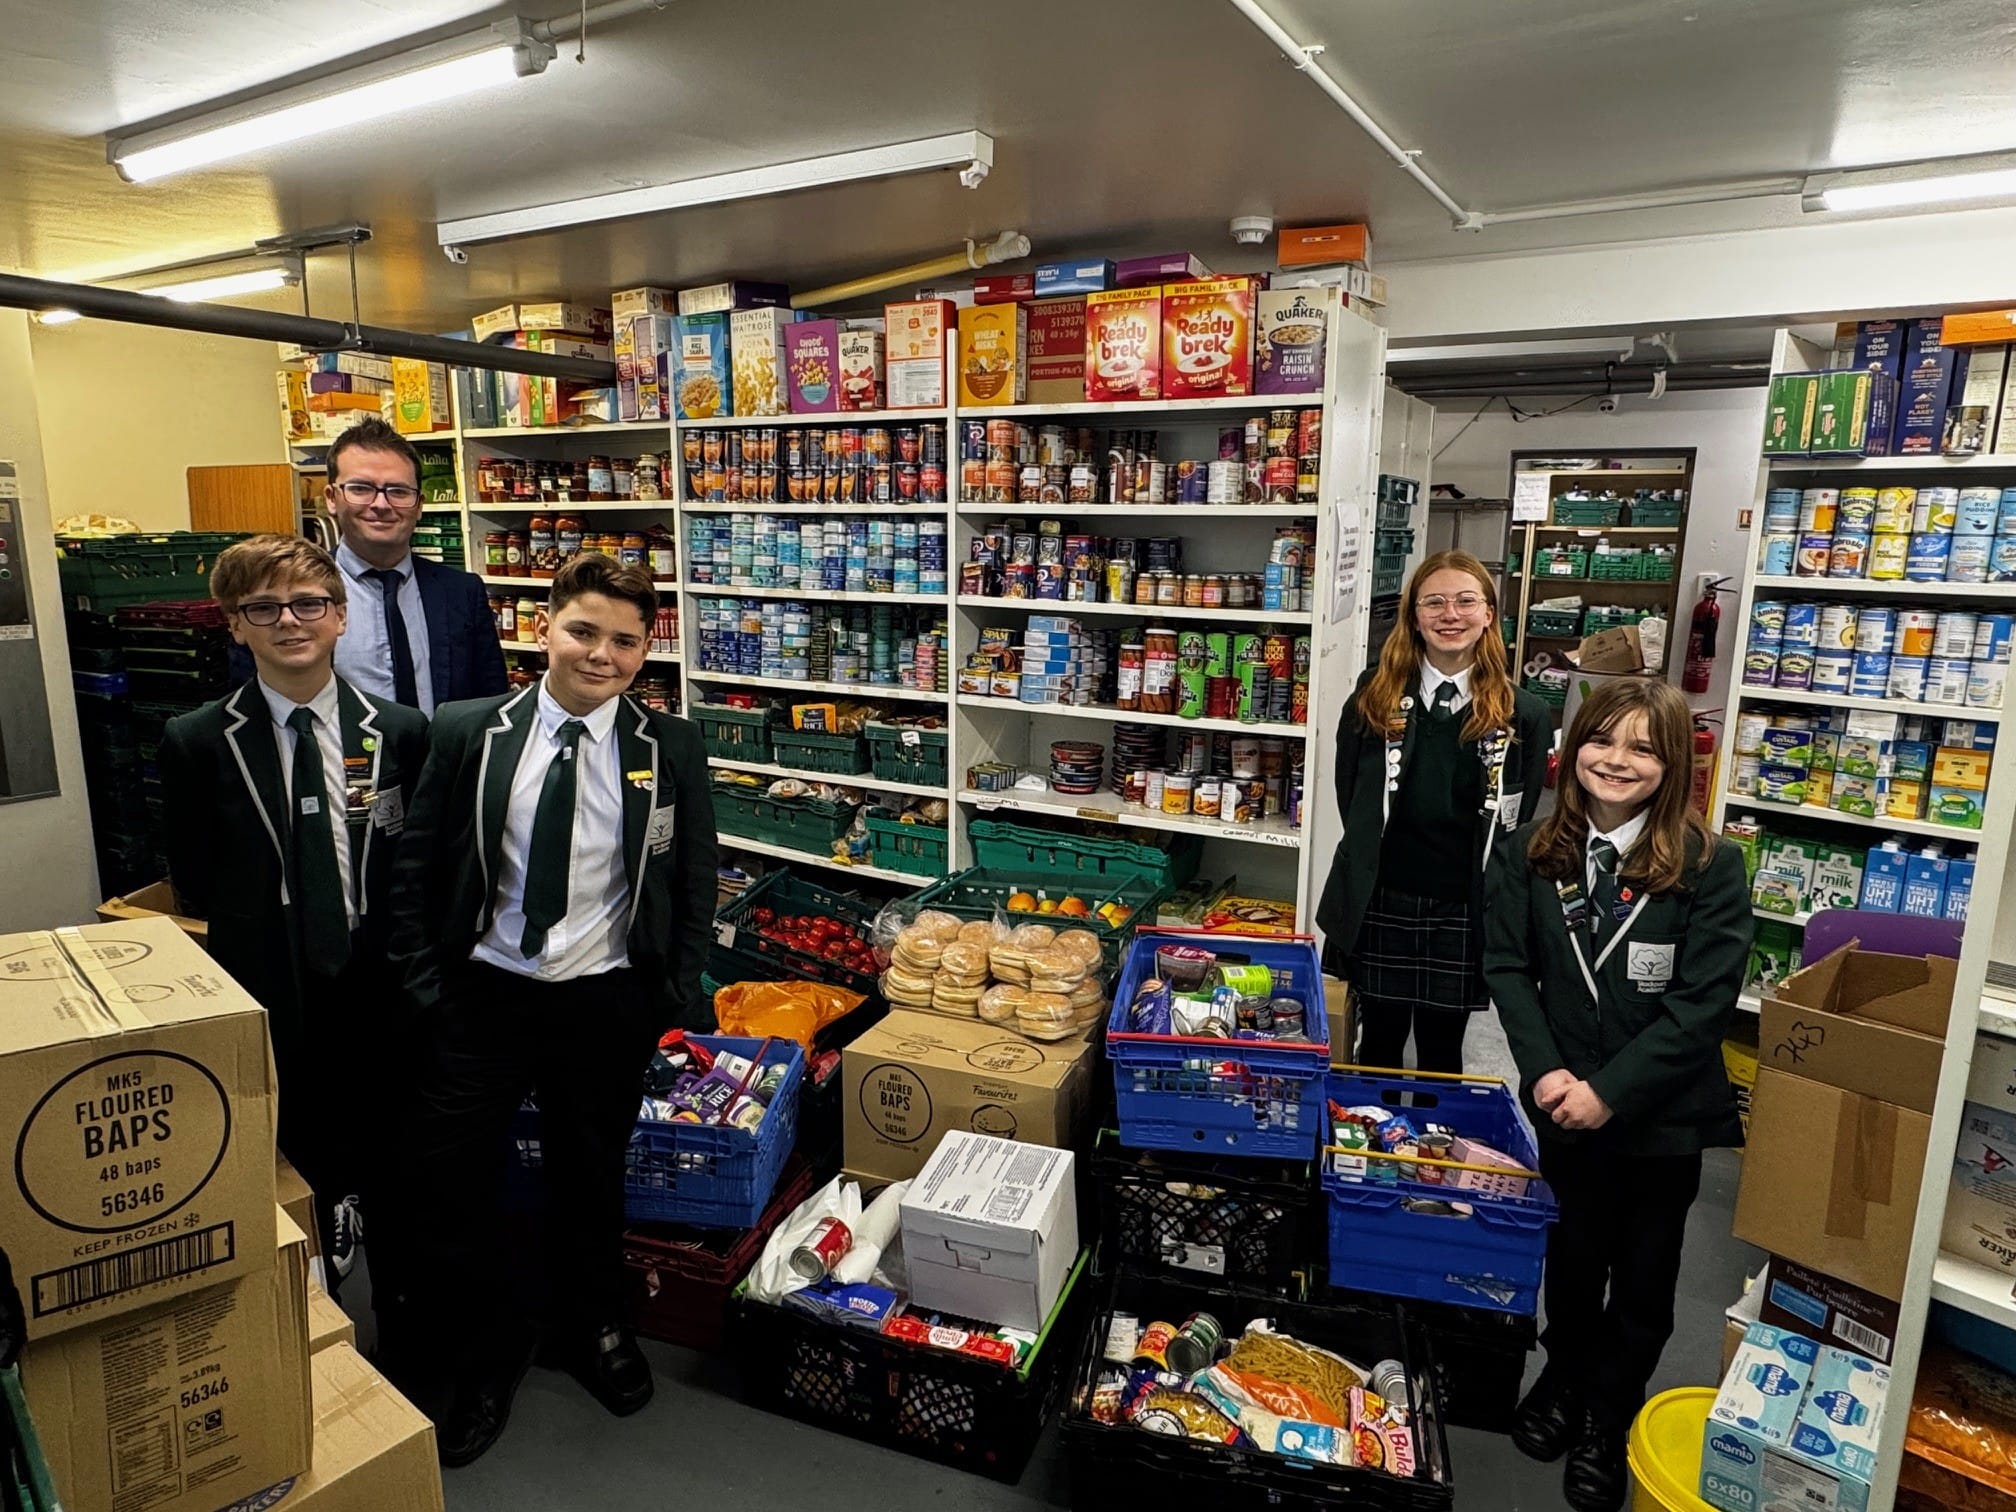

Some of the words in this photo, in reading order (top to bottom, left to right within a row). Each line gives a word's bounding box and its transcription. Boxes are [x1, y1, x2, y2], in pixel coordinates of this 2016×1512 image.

[1108, 291, 1132, 301] FAMILY
[1133, 289, 1152, 298] PACK
[1174, 285, 1188, 294] BIG
[1189, 283, 1217, 293] FAMILY
[1218, 281, 1239, 291] PACK
[732, 311, 772, 323] ESSENTIAL
[1051, 316, 1086, 328] 5139370
[1275, 307, 1325, 322] QUAKER
[974, 329, 1000, 341] WHEAT
[1098, 321, 1148, 344] Ready
[1176, 317, 1235, 338] Ready
[1871, 336, 1886, 345] ON
[1925, 332, 1940, 340] ON
[793, 347, 830, 358] SQUARES
[841, 345, 870, 357] QUAKER
[1101, 341, 1142, 361] brek
[1181, 334, 1227, 356] brek
[1866, 342, 1890, 352] YOUR
[1919, 346, 1943, 354] SIDE!
[1282, 355, 1313, 365] RAISIN
[1865, 350, 1889, 358] SIDE!
[1187, 369, 1223, 384] original
[1279, 363, 1316, 375] CRUNCH
[1106, 375, 1138, 388] original
[982, 630, 1009, 641] SPAM
[1268, 645, 1286, 653] HOT
[972, 656, 994, 666] SPAM
[1774, 864, 1805, 877] milk
[1819, 873, 1854, 889] milk
[1865, 886, 1895, 901] UHT
[1863, 896, 1894, 909] MILK
[1906, 894, 1937, 909] UHT
[1948, 900, 1969, 913] UH
[1904, 904, 1936, 917] MILK
[1946, 910, 1968, 921] MIL
[106, 1070, 142, 1092] MK5
[878, 1080, 912, 1096] FLOURED
[708, 1085, 736, 1112] RICE
[972, 1084, 1018, 1101] Favourites
[75, 1083, 174, 1125] FLOURED
[880, 1093, 911, 1111] BAPS
[84, 1109, 172, 1160] BAPS
[884, 1123, 907, 1137] 56346
[100, 1165, 119, 1182] 48
[125, 1156, 162, 1177] baps
[101, 1182, 165, 1217] 56346
[72, 1238, 111, 1258] KEEP
[116, 1220, 178, 1246] FROZEN
[1760, 1327, 1778, 1347] 6x80
[1761, 1366, 1786, 1396] mamia
[180, 1376, 229, 1409] 56346
[1829, 1391, 1853, 1424] mamia
[1799, 1430, 1814, 1447] BIG
[1814, 1436, 1827, 1453] BOX
[1711, 1437, 1755, 1463] mamia
[1842, 1446, 1859, 1469] 6x80
[1705, 1475, 1754, 1505] 6x80
